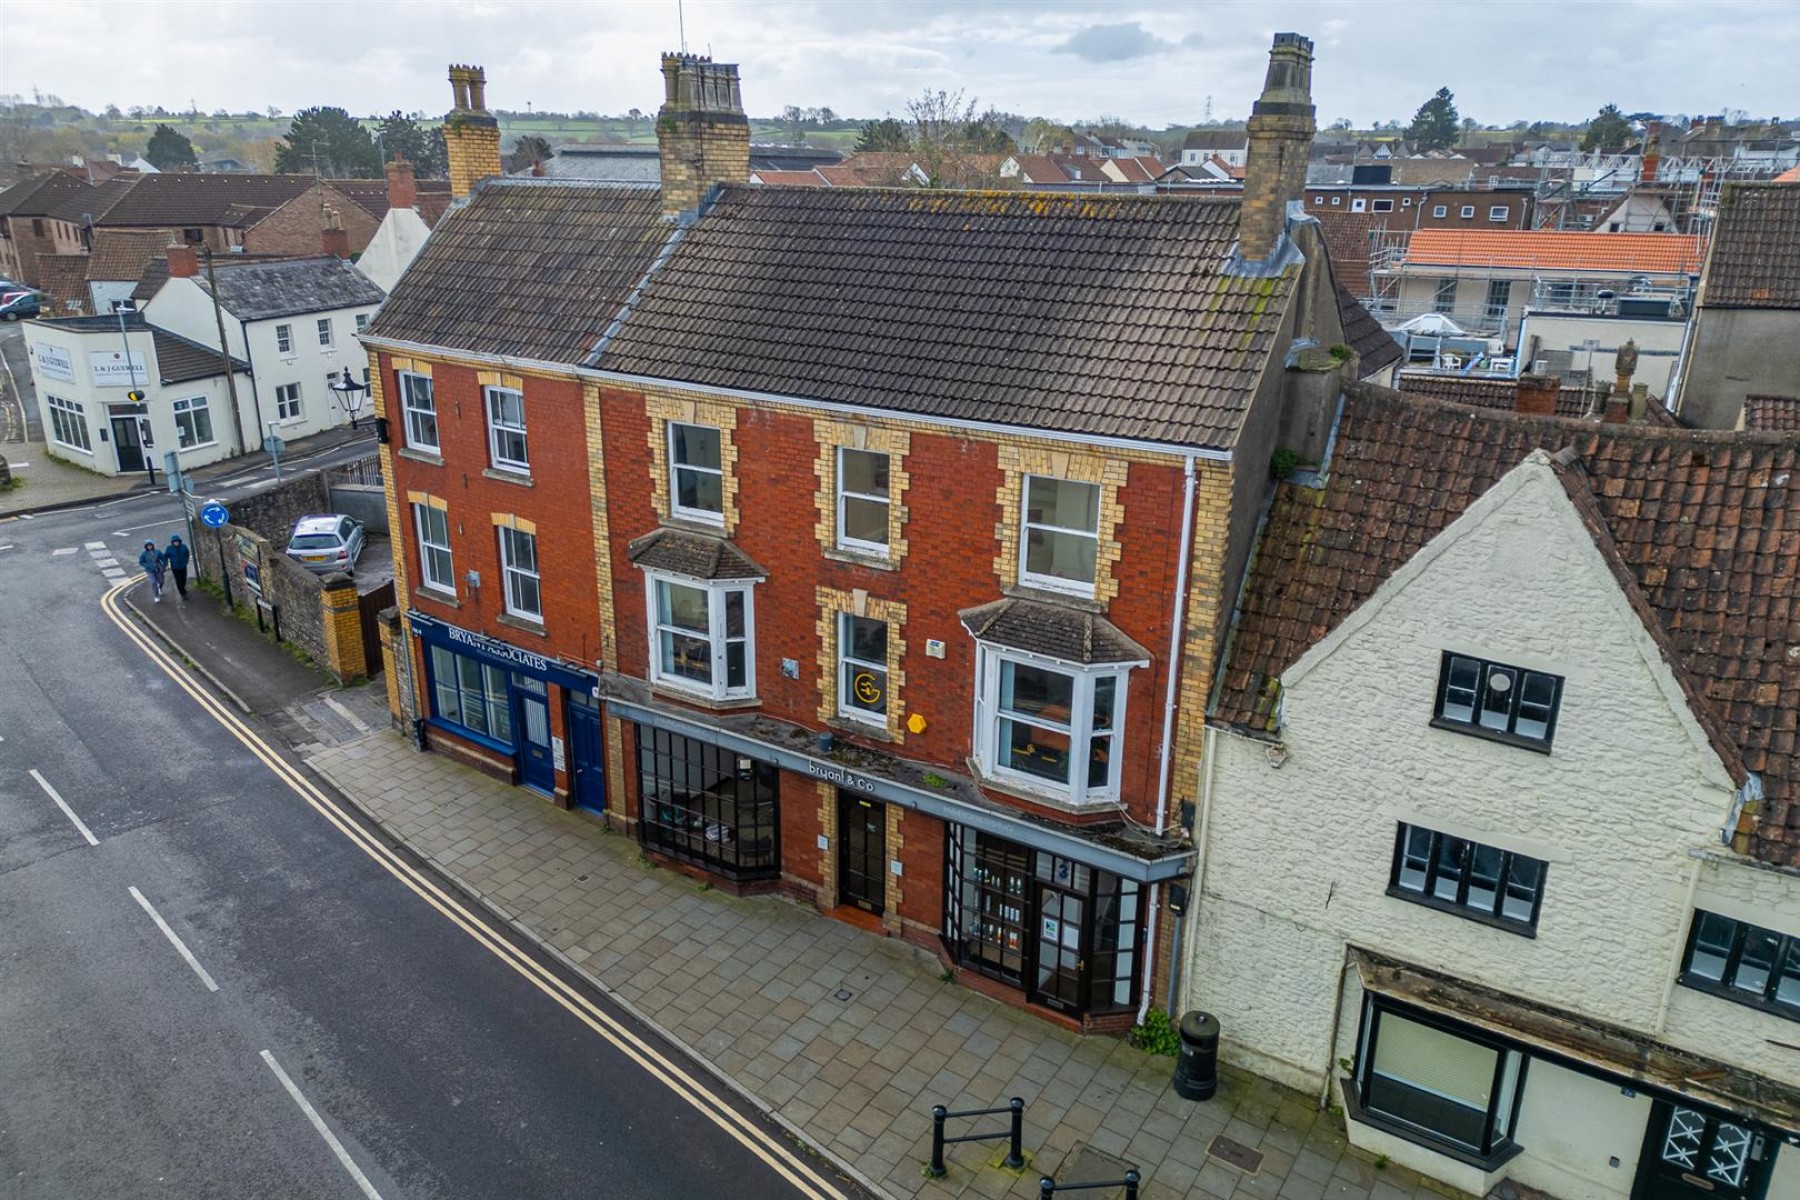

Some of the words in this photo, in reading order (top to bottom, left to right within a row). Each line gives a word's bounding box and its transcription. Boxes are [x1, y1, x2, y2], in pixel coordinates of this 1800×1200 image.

[847, 775, 855, 786] &
[858, 778, 874, 792] Co
[1058, 863, 1068, 879] 3
